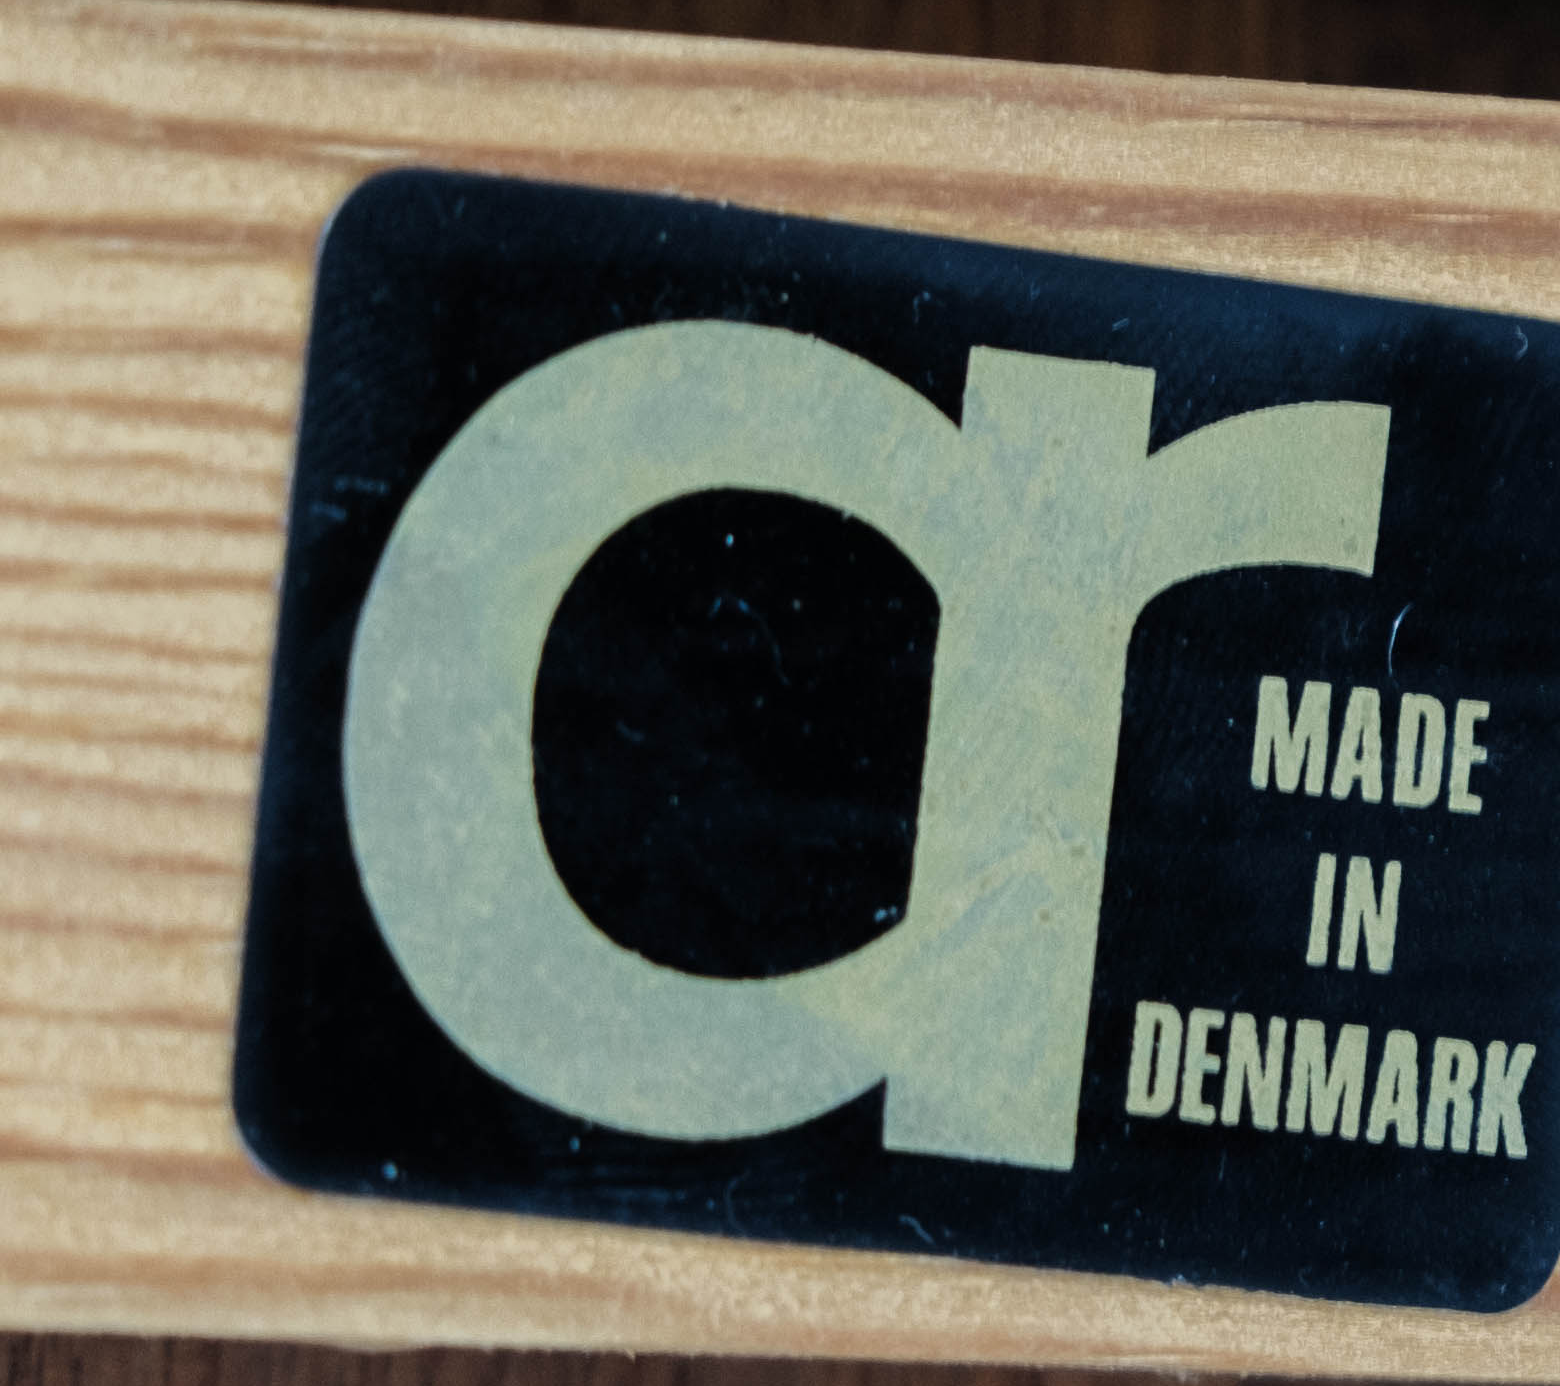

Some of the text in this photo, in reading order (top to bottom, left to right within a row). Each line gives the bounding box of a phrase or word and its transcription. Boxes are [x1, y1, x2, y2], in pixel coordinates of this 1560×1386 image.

[1250, 675, 1491, 815] MADE
[1305, 853, 1402, 974] IN
[1125, 1000, 1537, 1159] DENMARK
